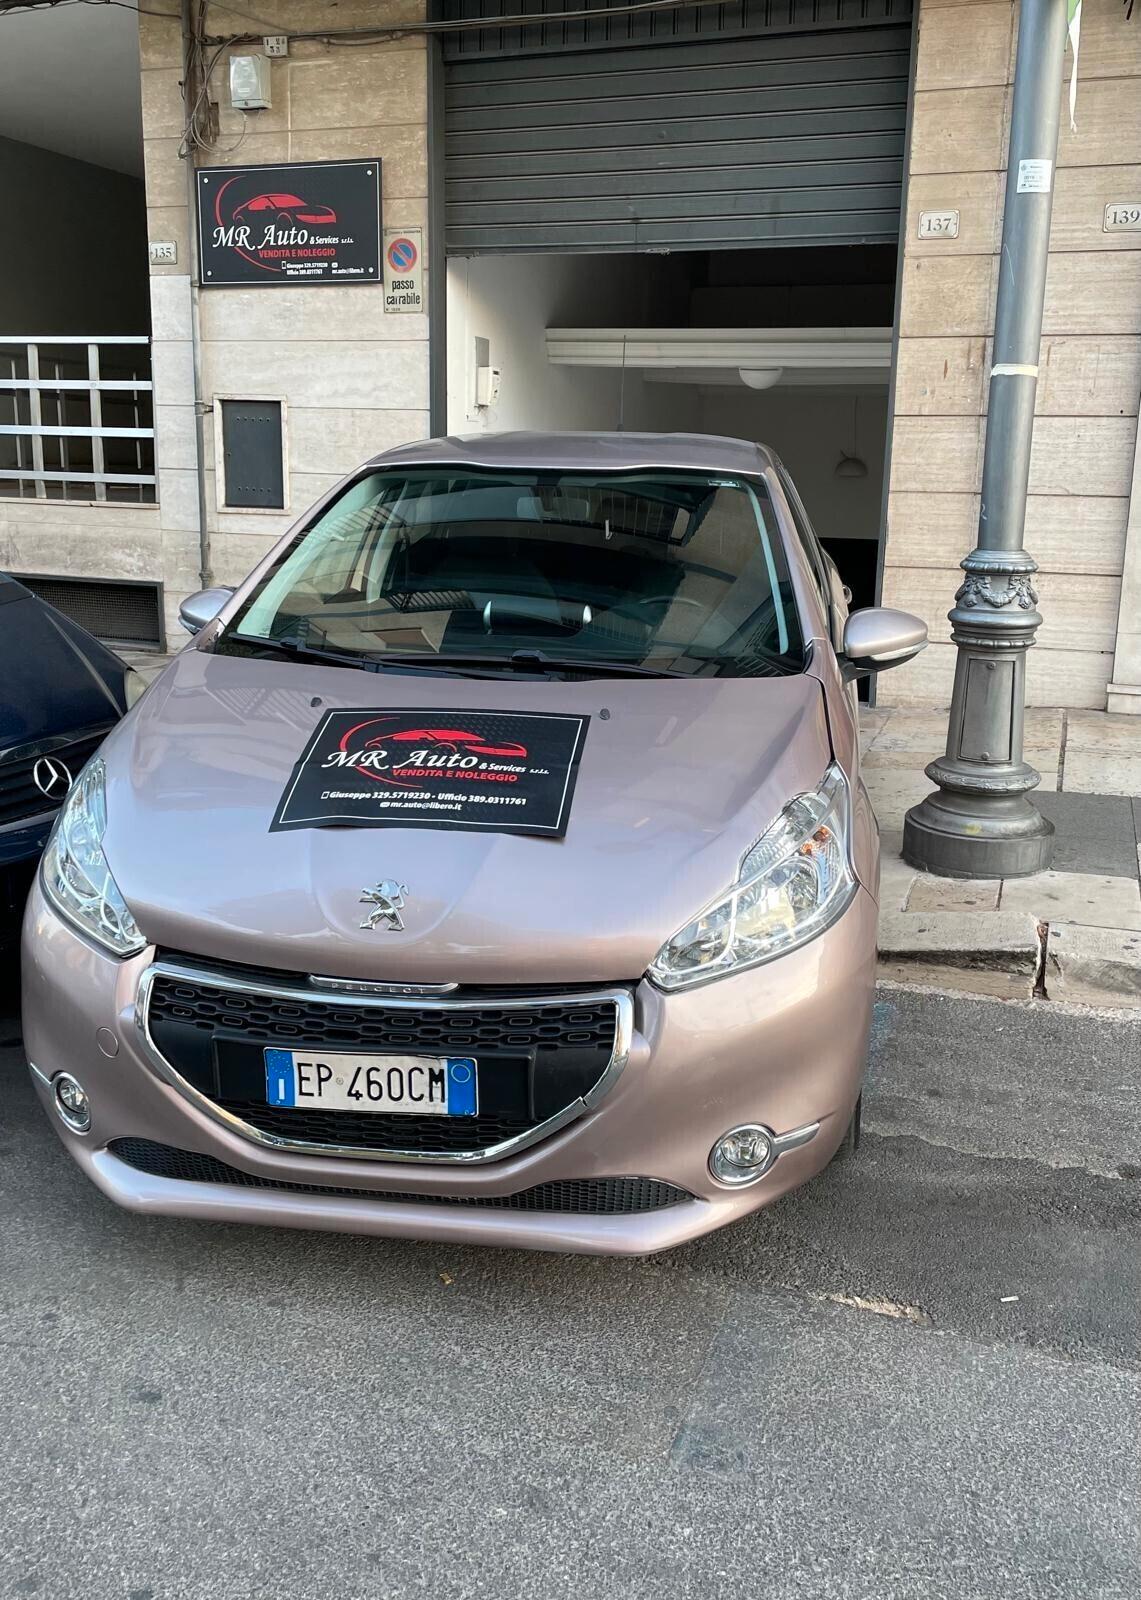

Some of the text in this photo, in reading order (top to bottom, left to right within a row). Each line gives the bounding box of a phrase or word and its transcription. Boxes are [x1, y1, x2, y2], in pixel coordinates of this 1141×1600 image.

[1112, 210, 1140, 224] 139
[927, 218, 952, 231] 137
[212, 225, 255, 250] MR
[257, 224, 309, 249] Auto
[315, 235, 339, 244] Services
[155, 247, 172, 258] 135
[258, 248, 336, 258] VENDITA E NOLEGGIO
[392, 280, 414, 292] passo
[386, 292, 421, 305] carrabile
[321, 750, 389, 770] MR
[392, 750, 478, 769] Auto
[488, 763, 527, 773] Services
[392, 769, 518, 782] VENDITA E NOLEGGIO
[329, 791, 371, 799] Giuseppe
[371, 791, 431, 800] 329.5719230
[437, 793, 467, 802] Ufficio
[468, 795, 527, 805] 389.0311761
[390, 801, 462, 811] mr.auto@libero.it
[297, 1062, 333, 1097] EP
[347, 1066, 446, 1103] 460CM
